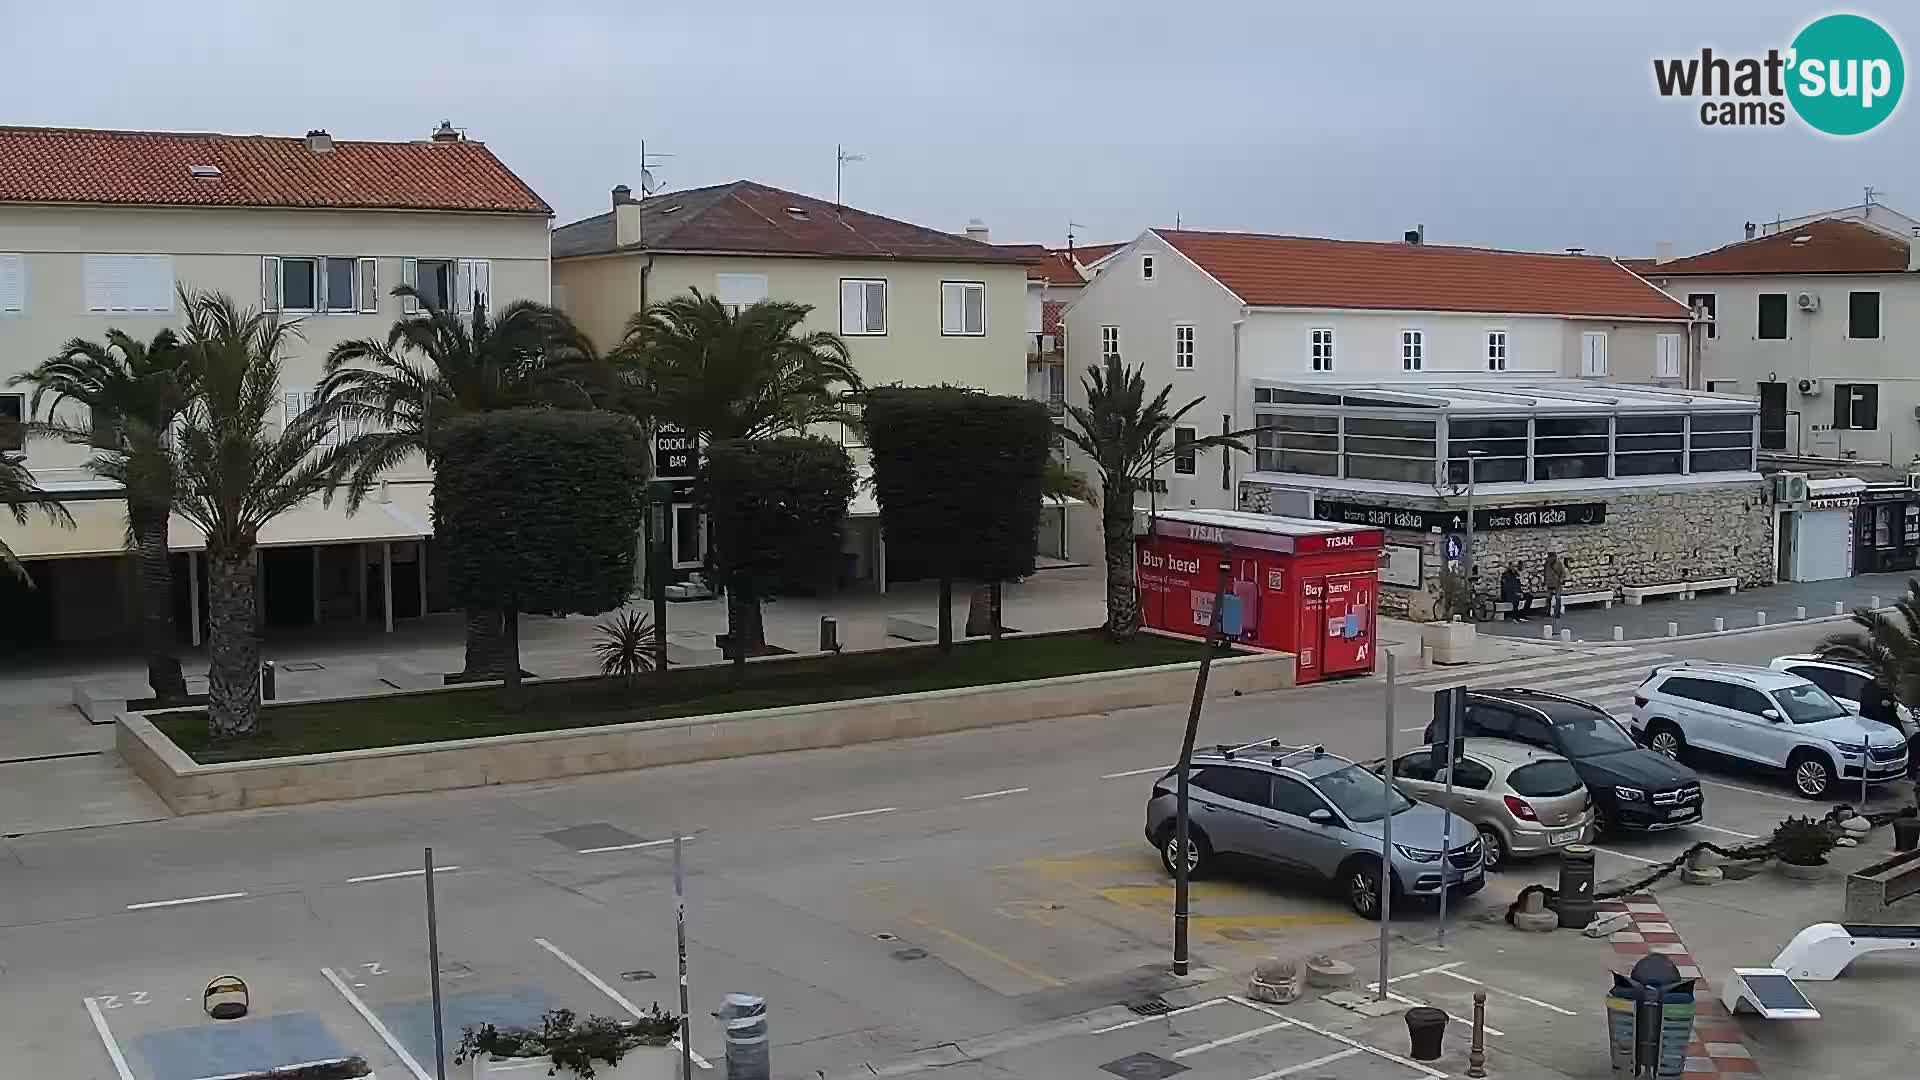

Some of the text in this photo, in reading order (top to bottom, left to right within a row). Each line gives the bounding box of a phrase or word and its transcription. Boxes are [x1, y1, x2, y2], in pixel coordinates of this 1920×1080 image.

[669, 455, 687, 467] BAR
[1187, 525, 1224, 543] TISAK
[1325, 535, 1354, 547] TISAK
[1143, 550, 1200, 574] Buy here!
[1305, 584, 1323, 597] Buy
